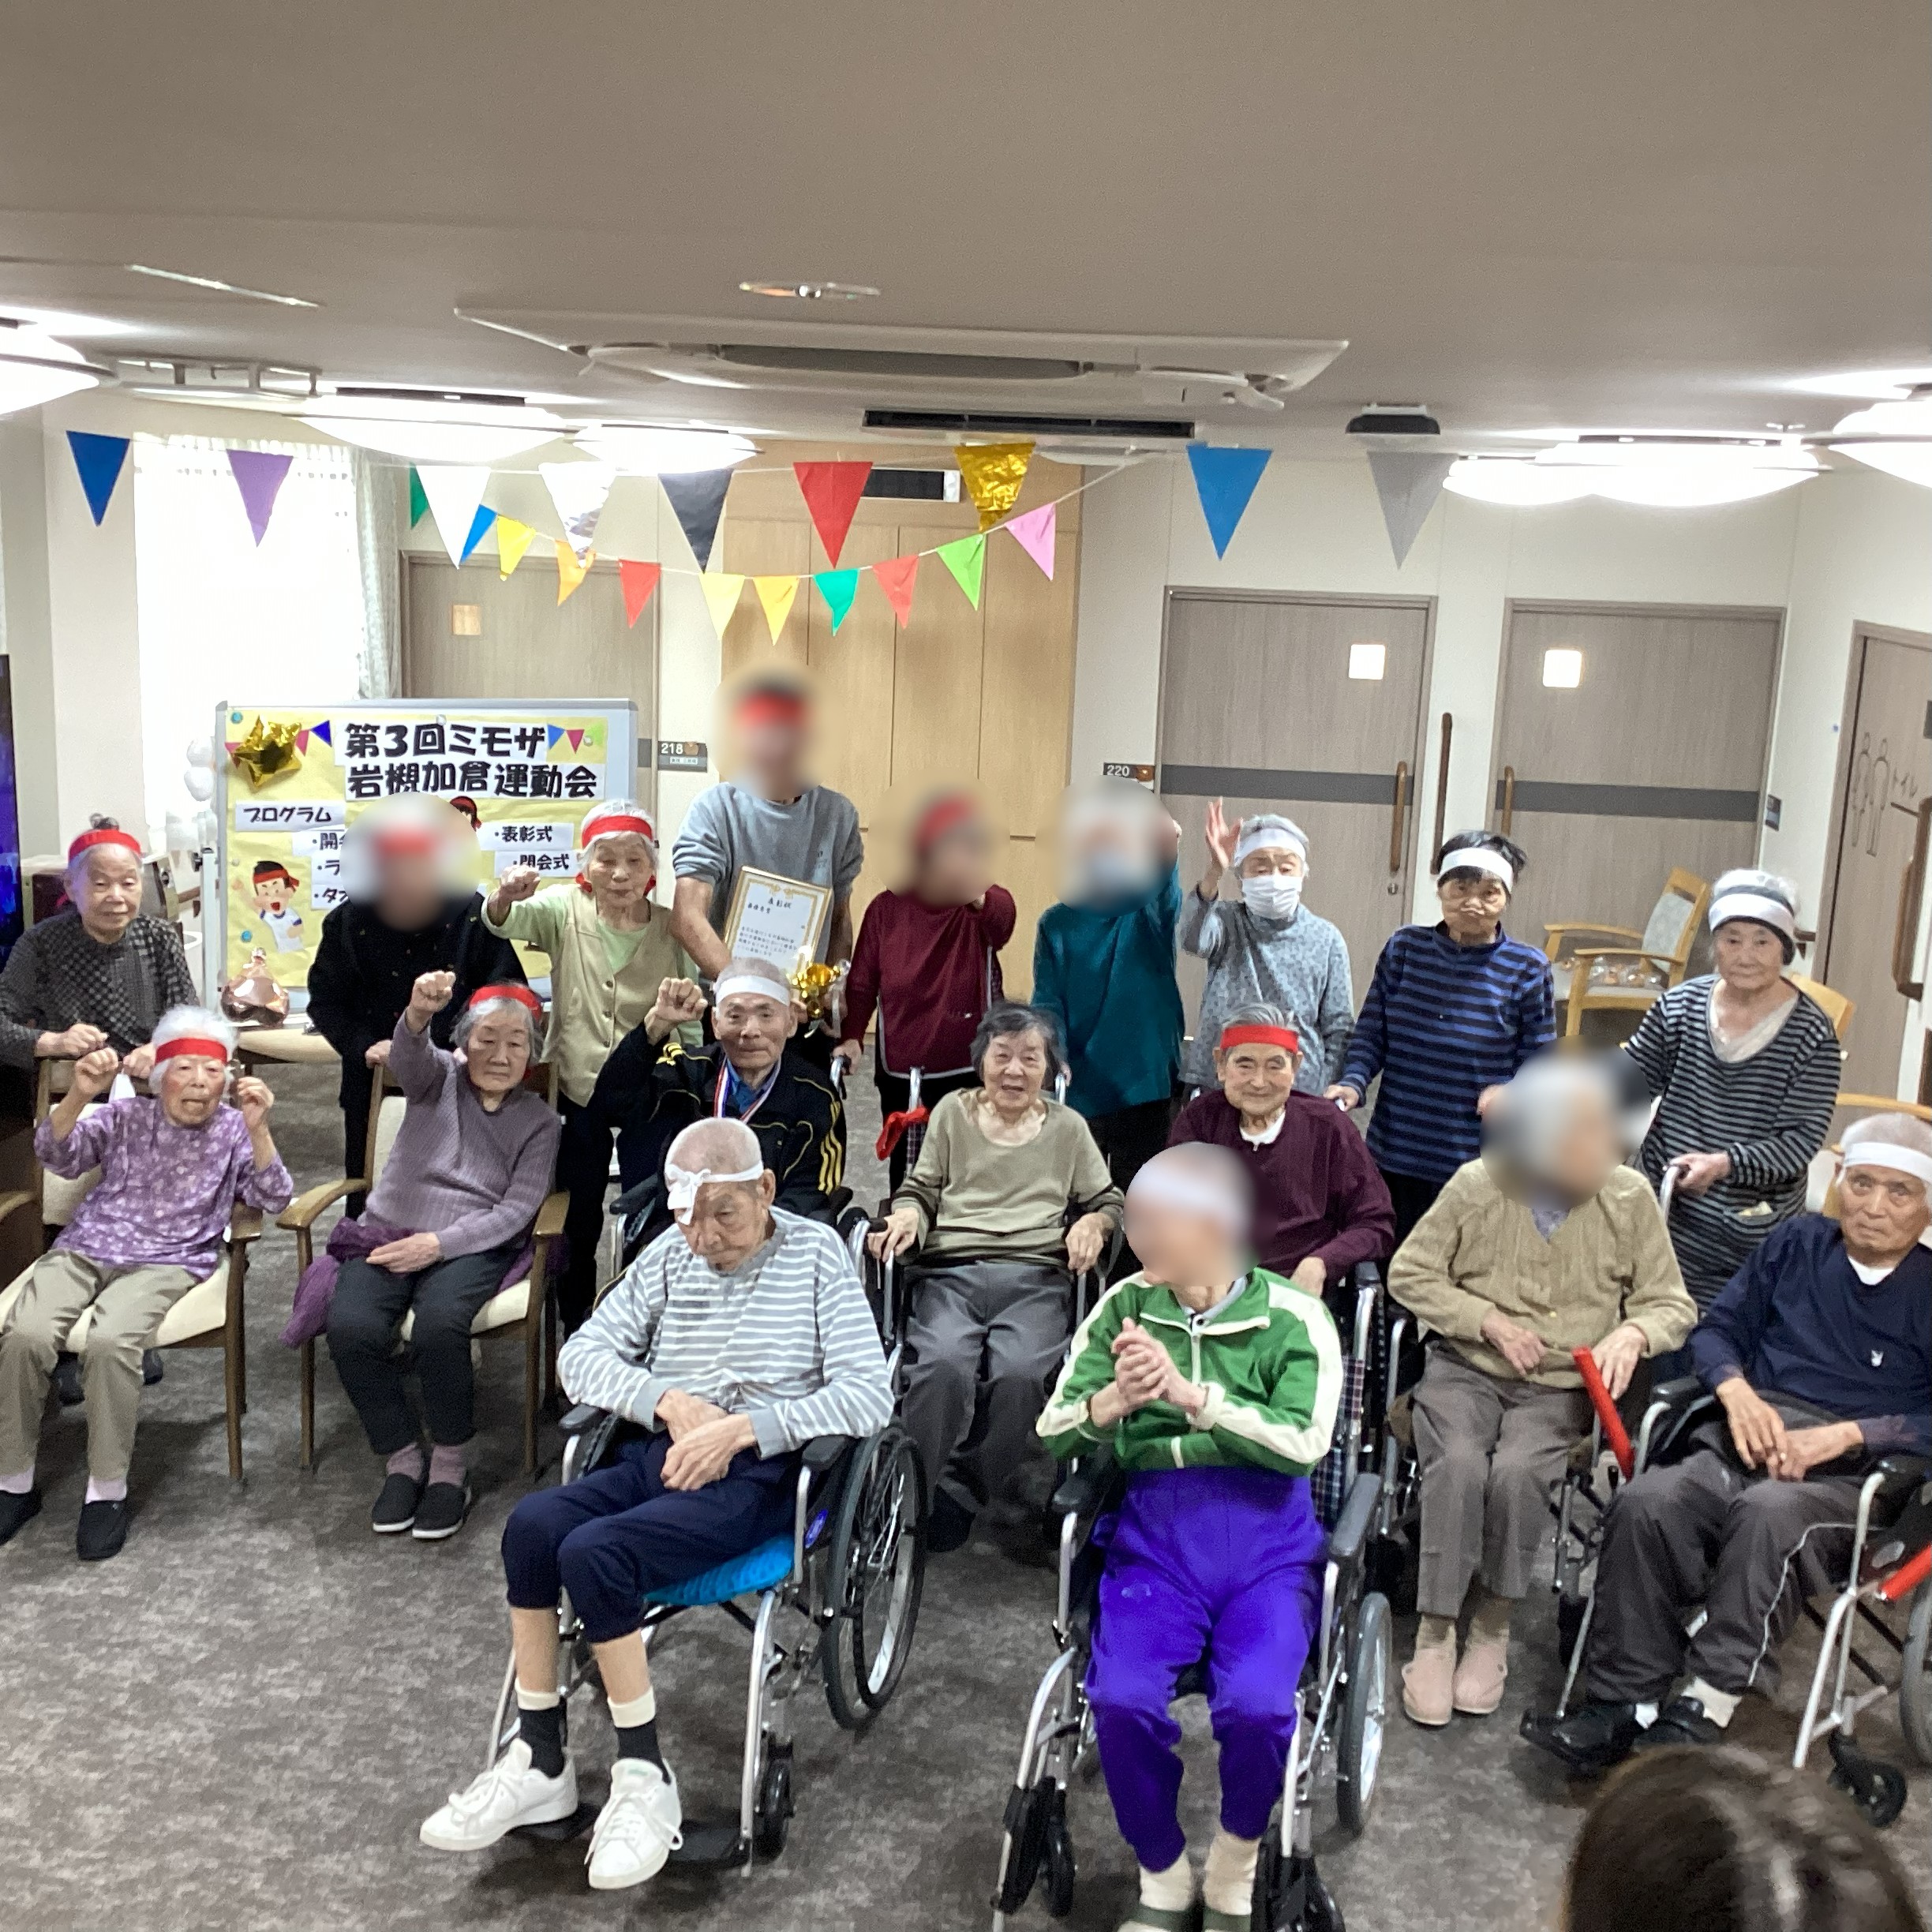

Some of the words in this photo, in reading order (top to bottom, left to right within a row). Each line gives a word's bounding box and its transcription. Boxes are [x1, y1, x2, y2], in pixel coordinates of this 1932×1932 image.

[345, 723, 545, 758] 第3回ミモザ
[661, 743, 683, 754] 218
[1107, 765, 1129, 777] 220
[347, 761, 597, 799] 岩槻加倉運動会
[243, 807, 332, 822] プログラム
